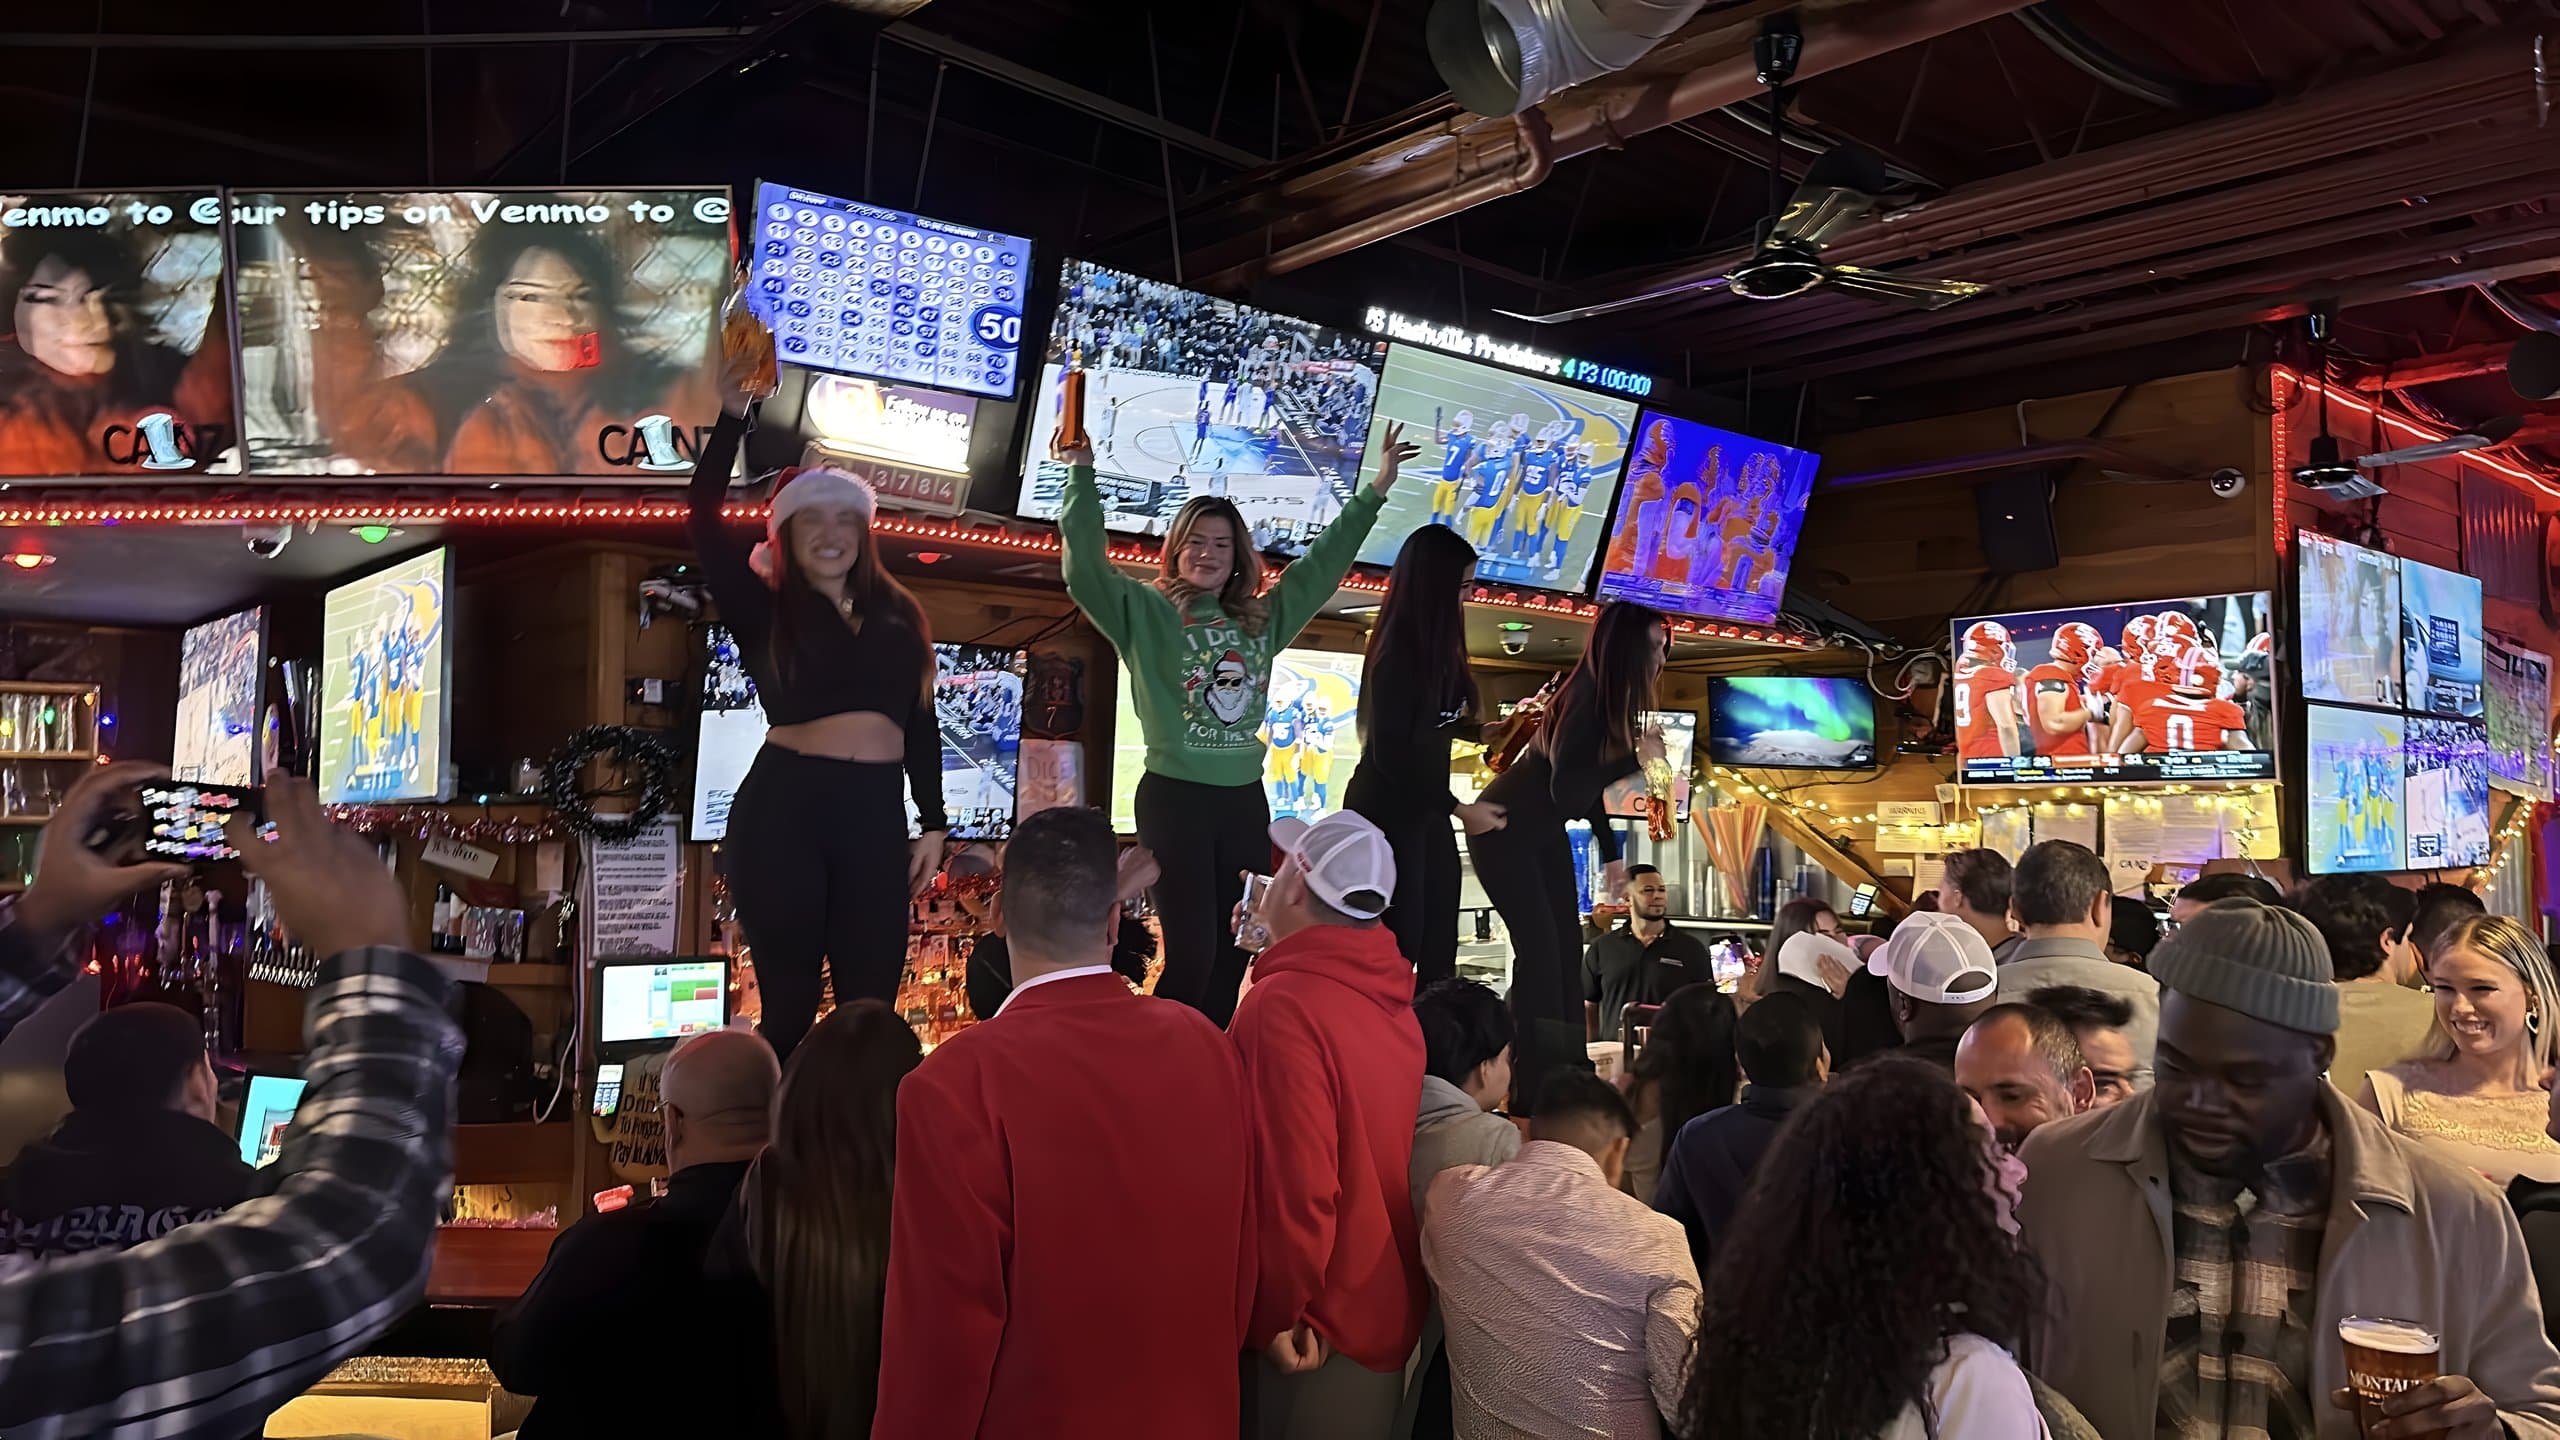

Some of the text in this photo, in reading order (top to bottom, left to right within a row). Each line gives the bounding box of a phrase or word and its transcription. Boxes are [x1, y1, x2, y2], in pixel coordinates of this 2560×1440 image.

[125, 201, 173, 225] to
[304, 201, 385, 230] tips
[403, 205, 452, 224] on
[471, 199, 610, 223] Venmo
[627, 200, 674, 223] to
[693, 197, 729, 223] @
[979, 312, 1021, 343] 50
[1389, 311, 1473, 354] Nashville
[1475, 334, 1562, 375] Predators
[1562, 358, 1576, 378] 4
[1578, 360, 1600, 384] P3
[1204, 628, 1240, 647] DO
[1189, 722, 1217, 740] FOR
[624, 1094, 661, 1113] Drin
